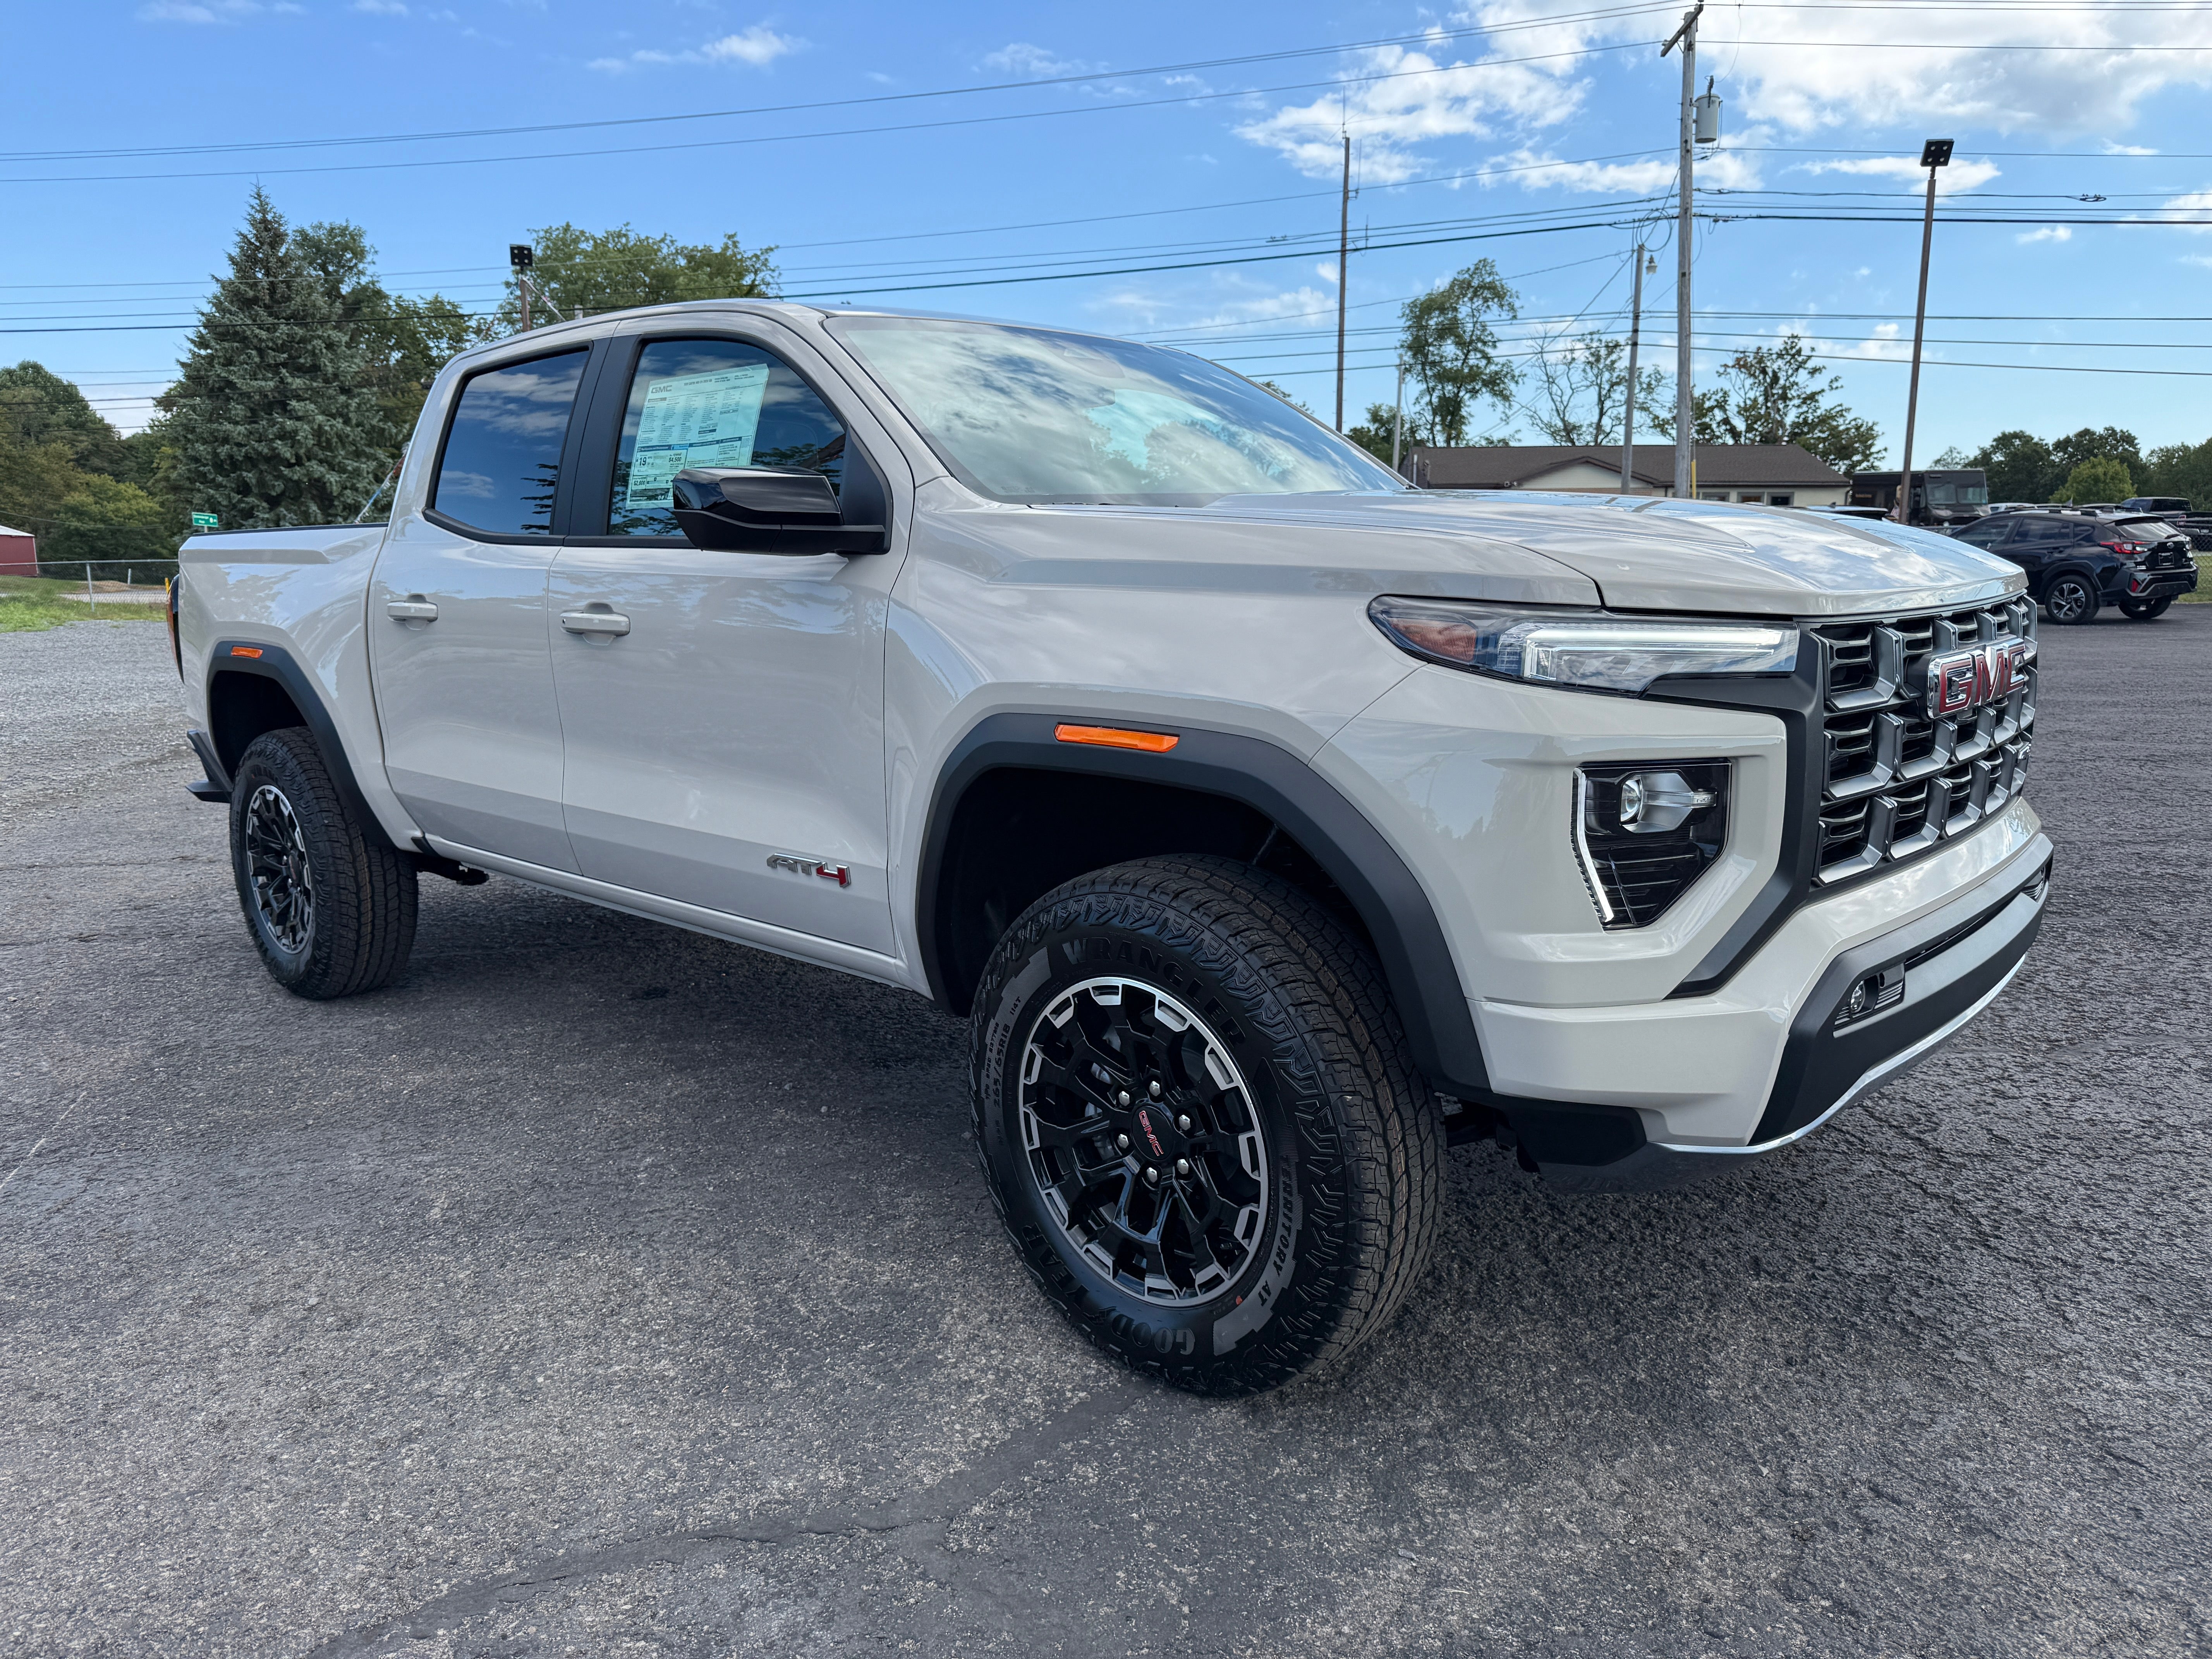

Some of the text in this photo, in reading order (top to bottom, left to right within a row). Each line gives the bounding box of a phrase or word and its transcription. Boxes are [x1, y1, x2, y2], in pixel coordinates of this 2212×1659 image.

[651, 385, 672, 393] GMC
[639, 457, 647, 466] 19
[1929, 638, 2025, 719] GMC
[767, 853, 851, 888] AT4
[1062, 937, 1246, 1048] WRANGLER
[993, 1023, 1010, 1108] 265/65R18
[1010, 996, 1021, 1016] 114T
[1139, 1111, 1164, 1156] GMC
[1258, 1279, 1272, 1307] AT
